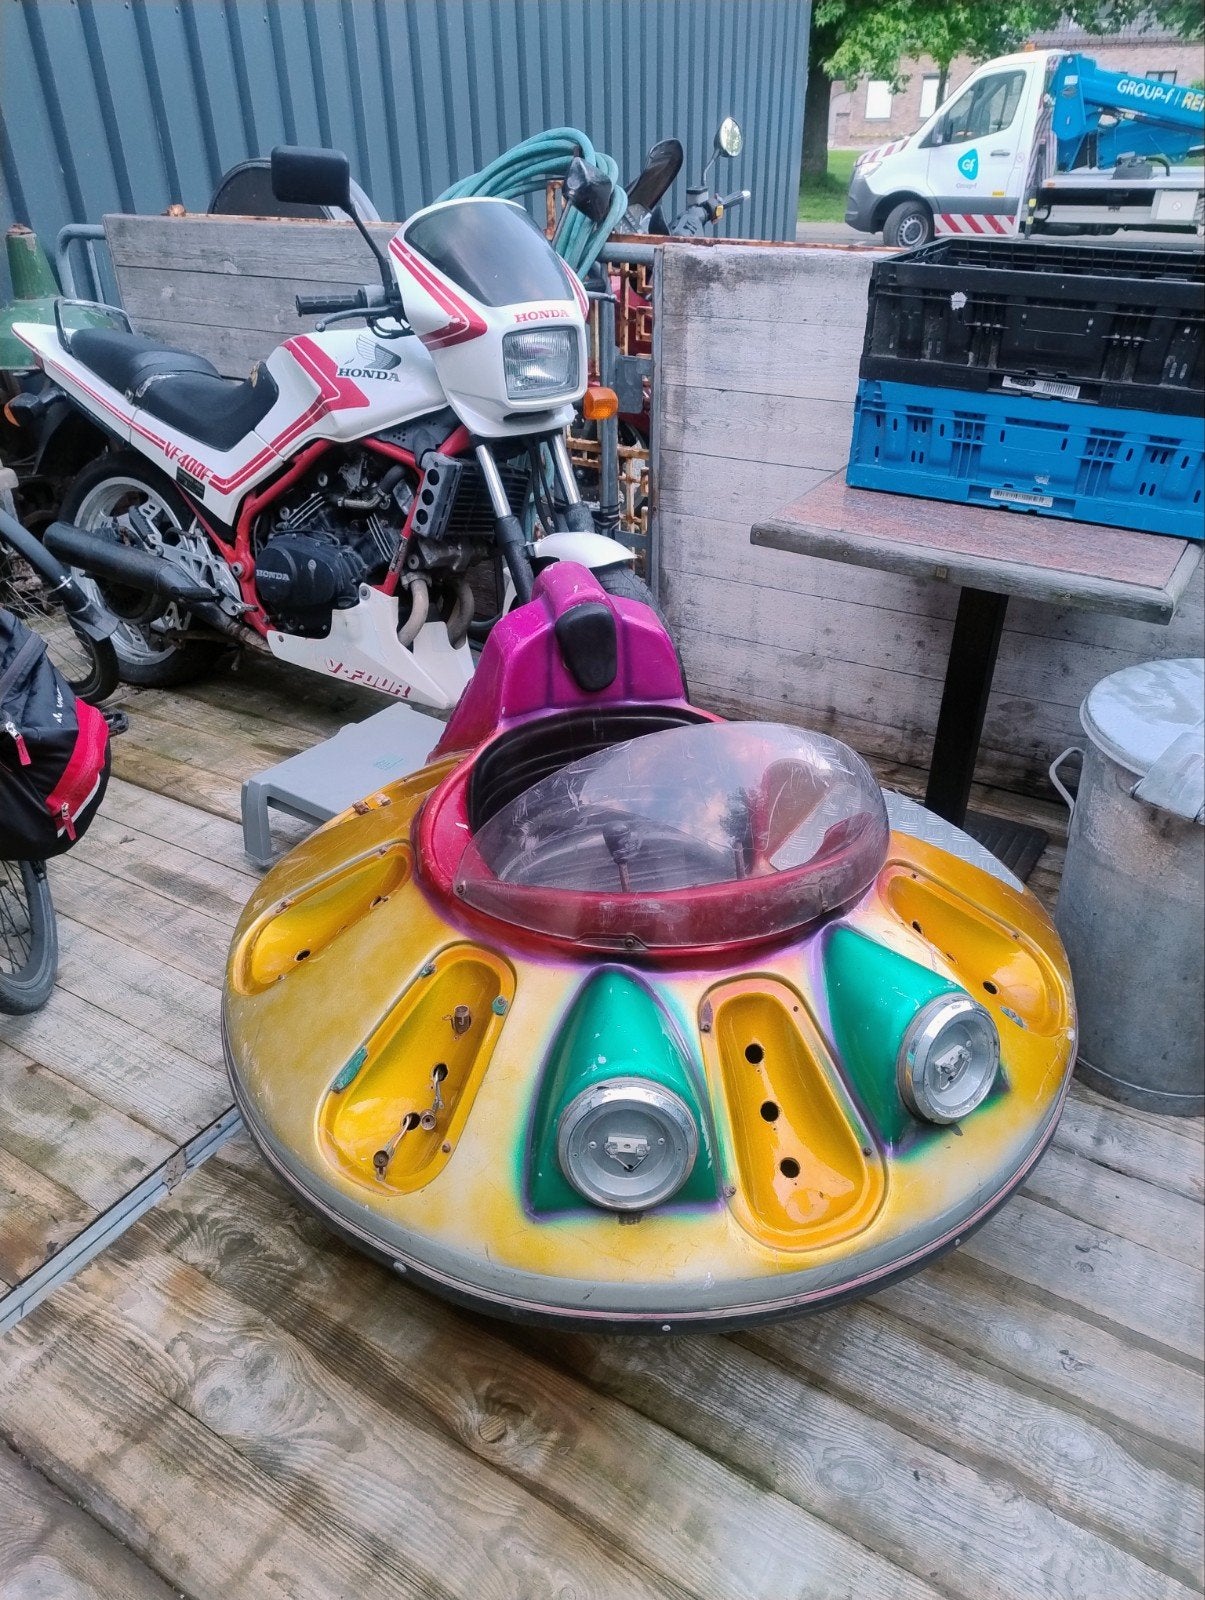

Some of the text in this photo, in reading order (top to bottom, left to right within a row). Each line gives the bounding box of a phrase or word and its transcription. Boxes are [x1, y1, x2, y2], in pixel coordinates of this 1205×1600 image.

[1117, 79, 1175, 104] GROUP-f
[514, 309, 570, 323] HONDA
[337, 367, 401, 382] HONDA
[164, 441, 214, 481] VF400F
[256, 569, 290, 581] HONDA
